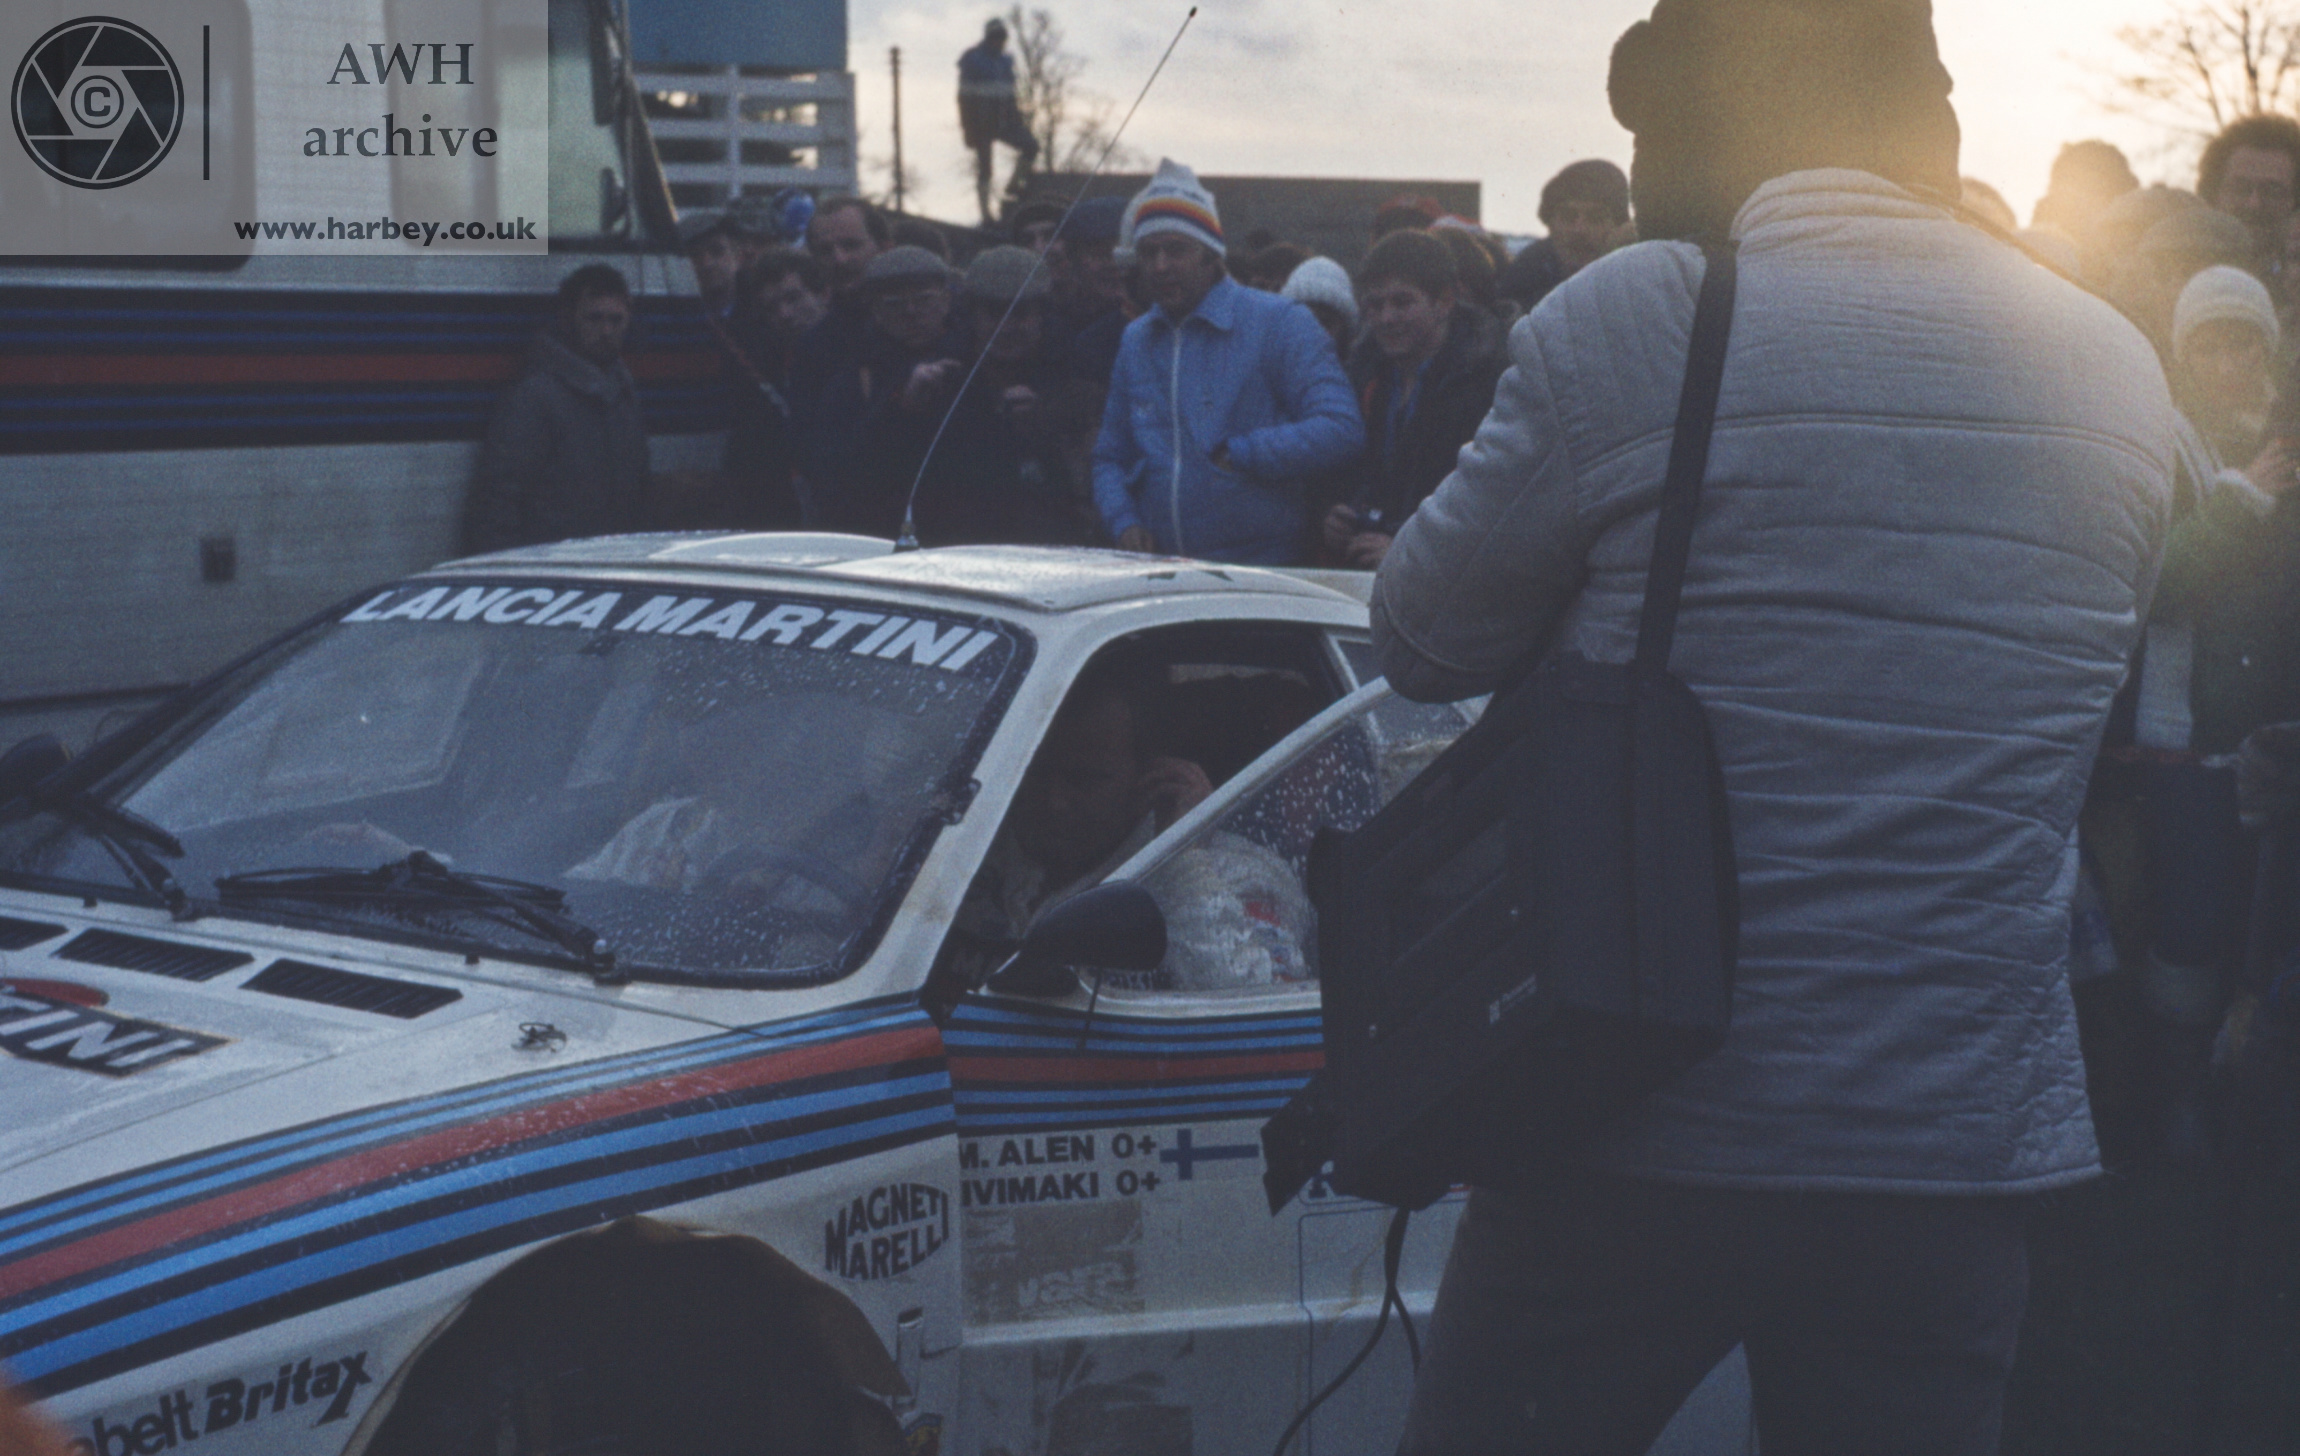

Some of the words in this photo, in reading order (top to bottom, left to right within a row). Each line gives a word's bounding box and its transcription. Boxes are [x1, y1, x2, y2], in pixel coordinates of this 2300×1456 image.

[340, 586, 622, 632] LANCIA
[613, 595, 998, 672] MARTINI
[998, 1134, 1095, 1167] ALEN
[825, 1183, 949, 1252] MAGNETI
[961, 1171, 1099, 1207] IVIMAKI
[825, 1212, 949, 1280] MARELLI
[205, 1351, 372, 1435] Britax
